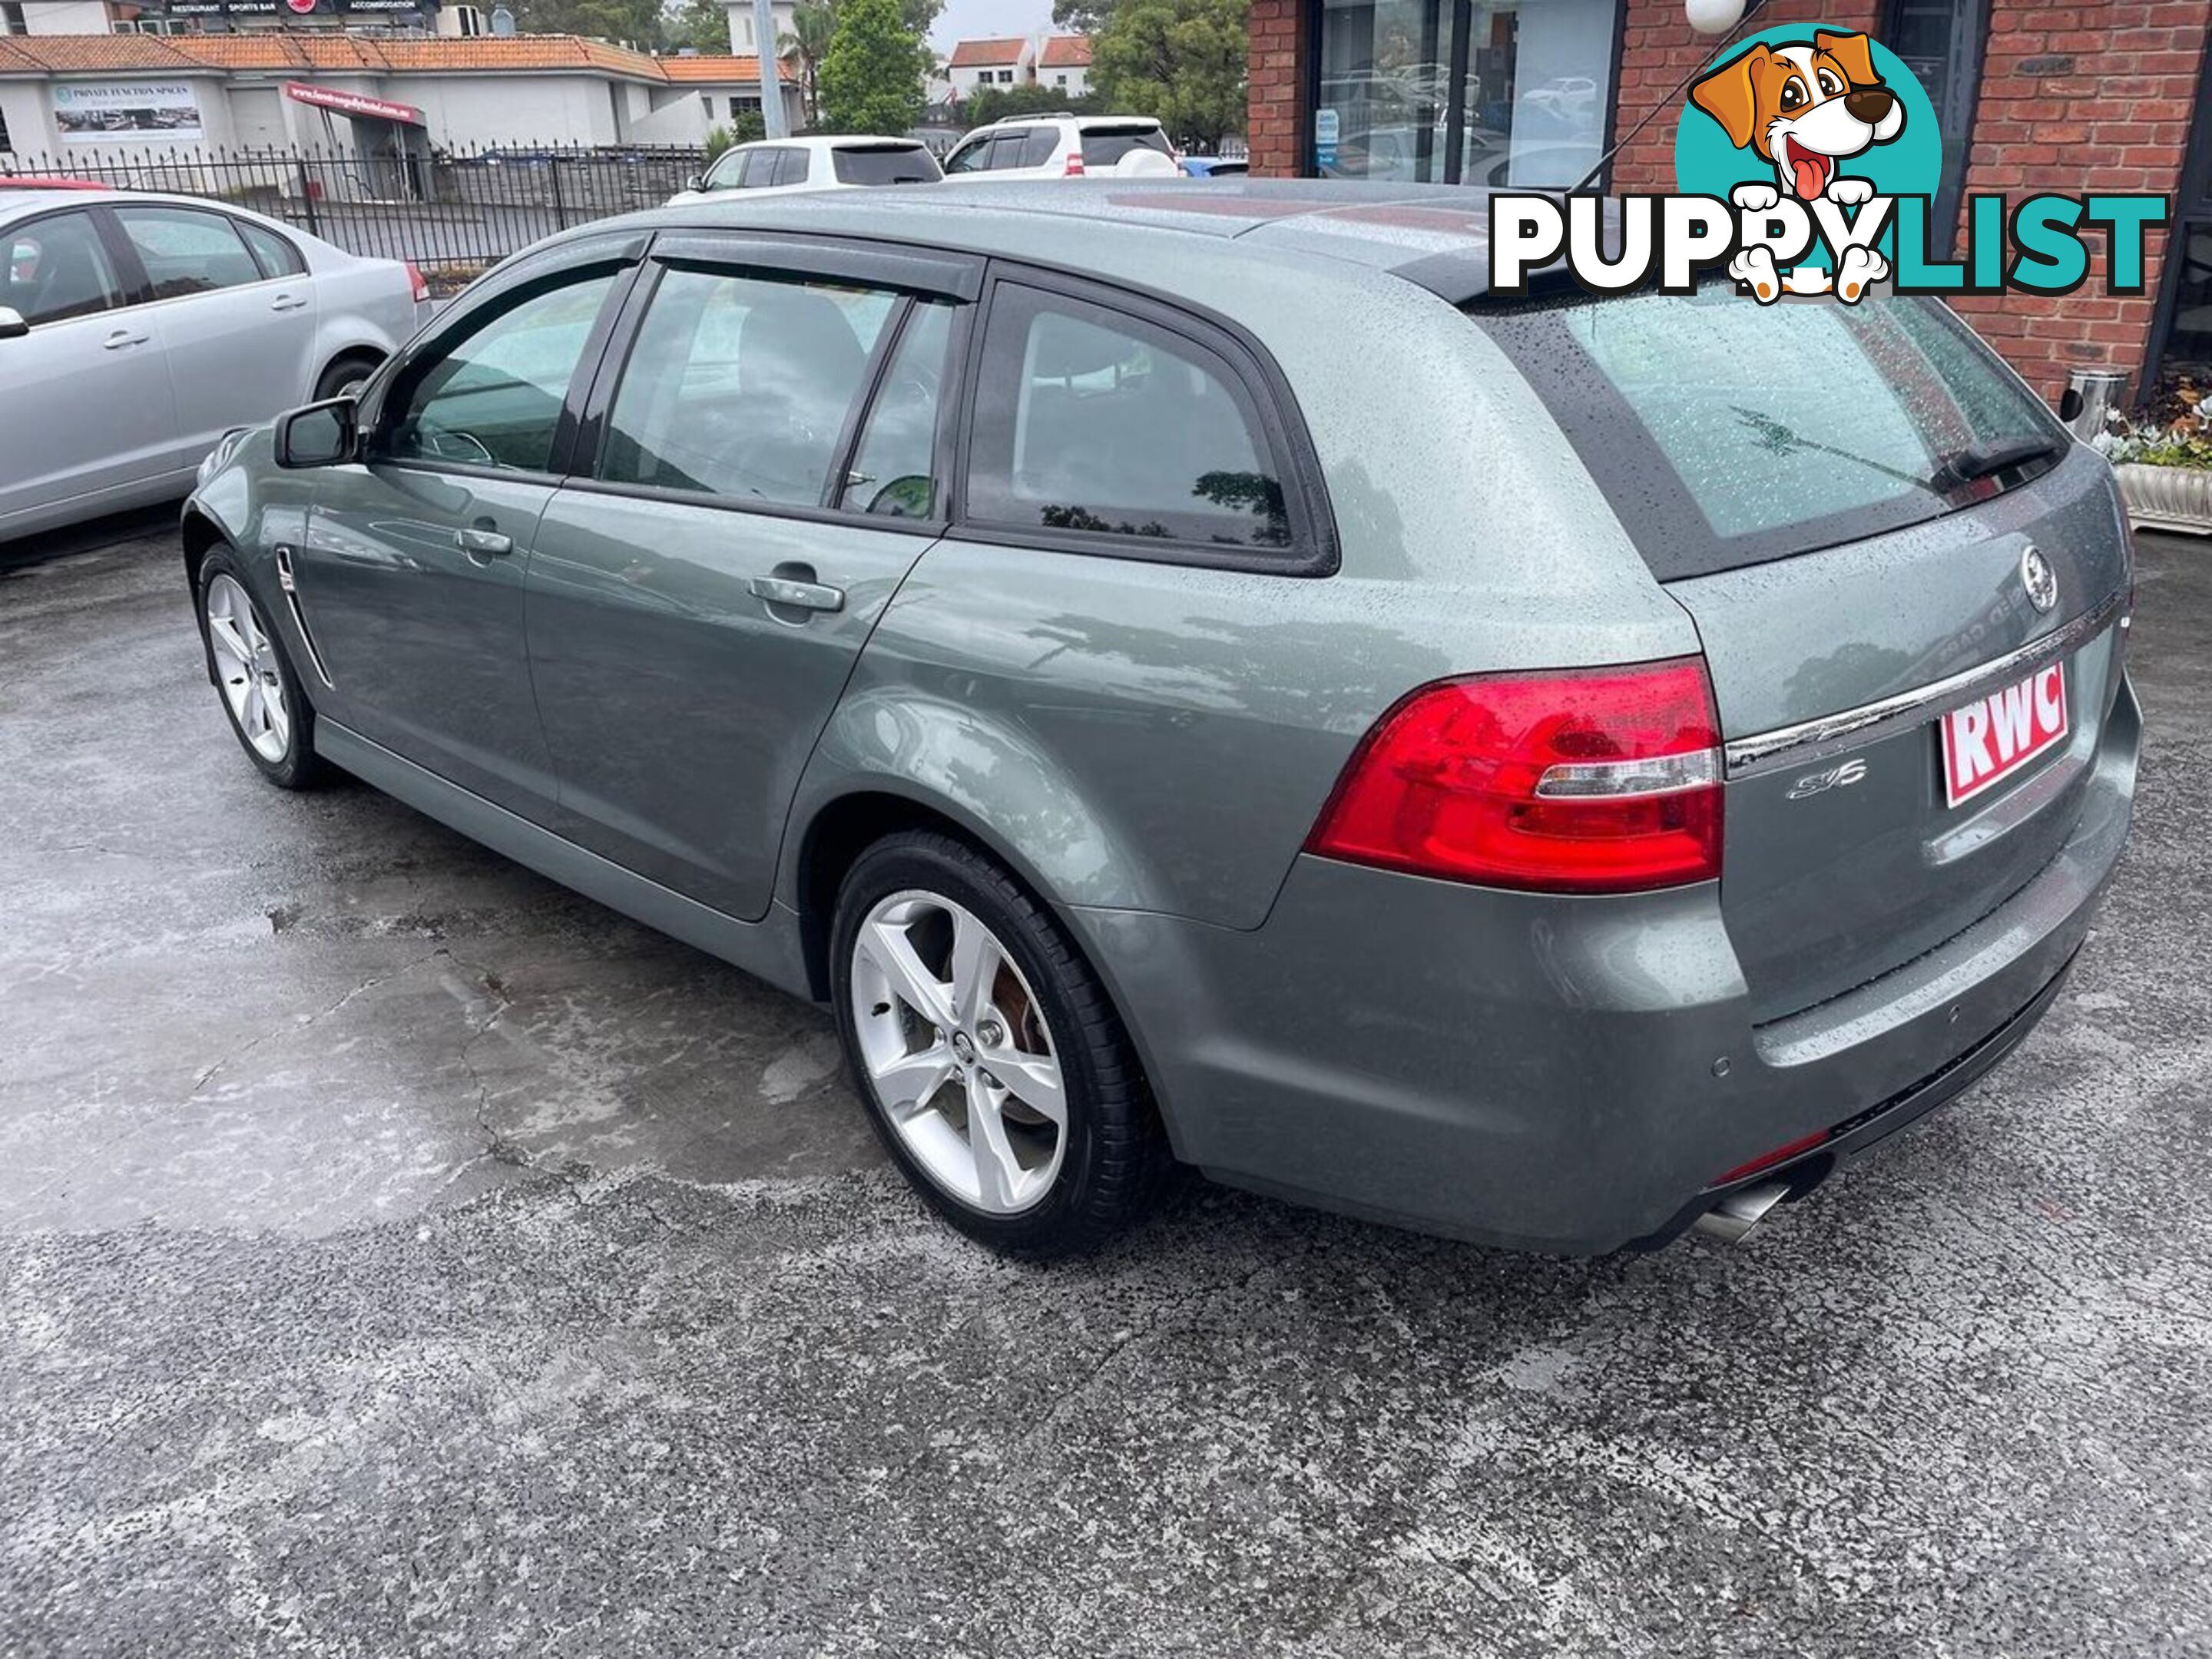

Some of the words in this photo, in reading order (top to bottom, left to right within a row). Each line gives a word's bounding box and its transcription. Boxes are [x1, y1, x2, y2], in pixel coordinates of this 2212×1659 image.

[171, 4, 221, 12] RESTAURANT
[228, 3, 258, 12] SPORTS
[260, 2, 276, 11] BAR
[73, 88, 108, 98] PRIVATE
[110, 87, 154, 97] FUNCTION
[156, 86, 188, 95] SPACES
[1952, 664, 2061, 790] RWC
[1786, 758, 1867, 799] SV6
